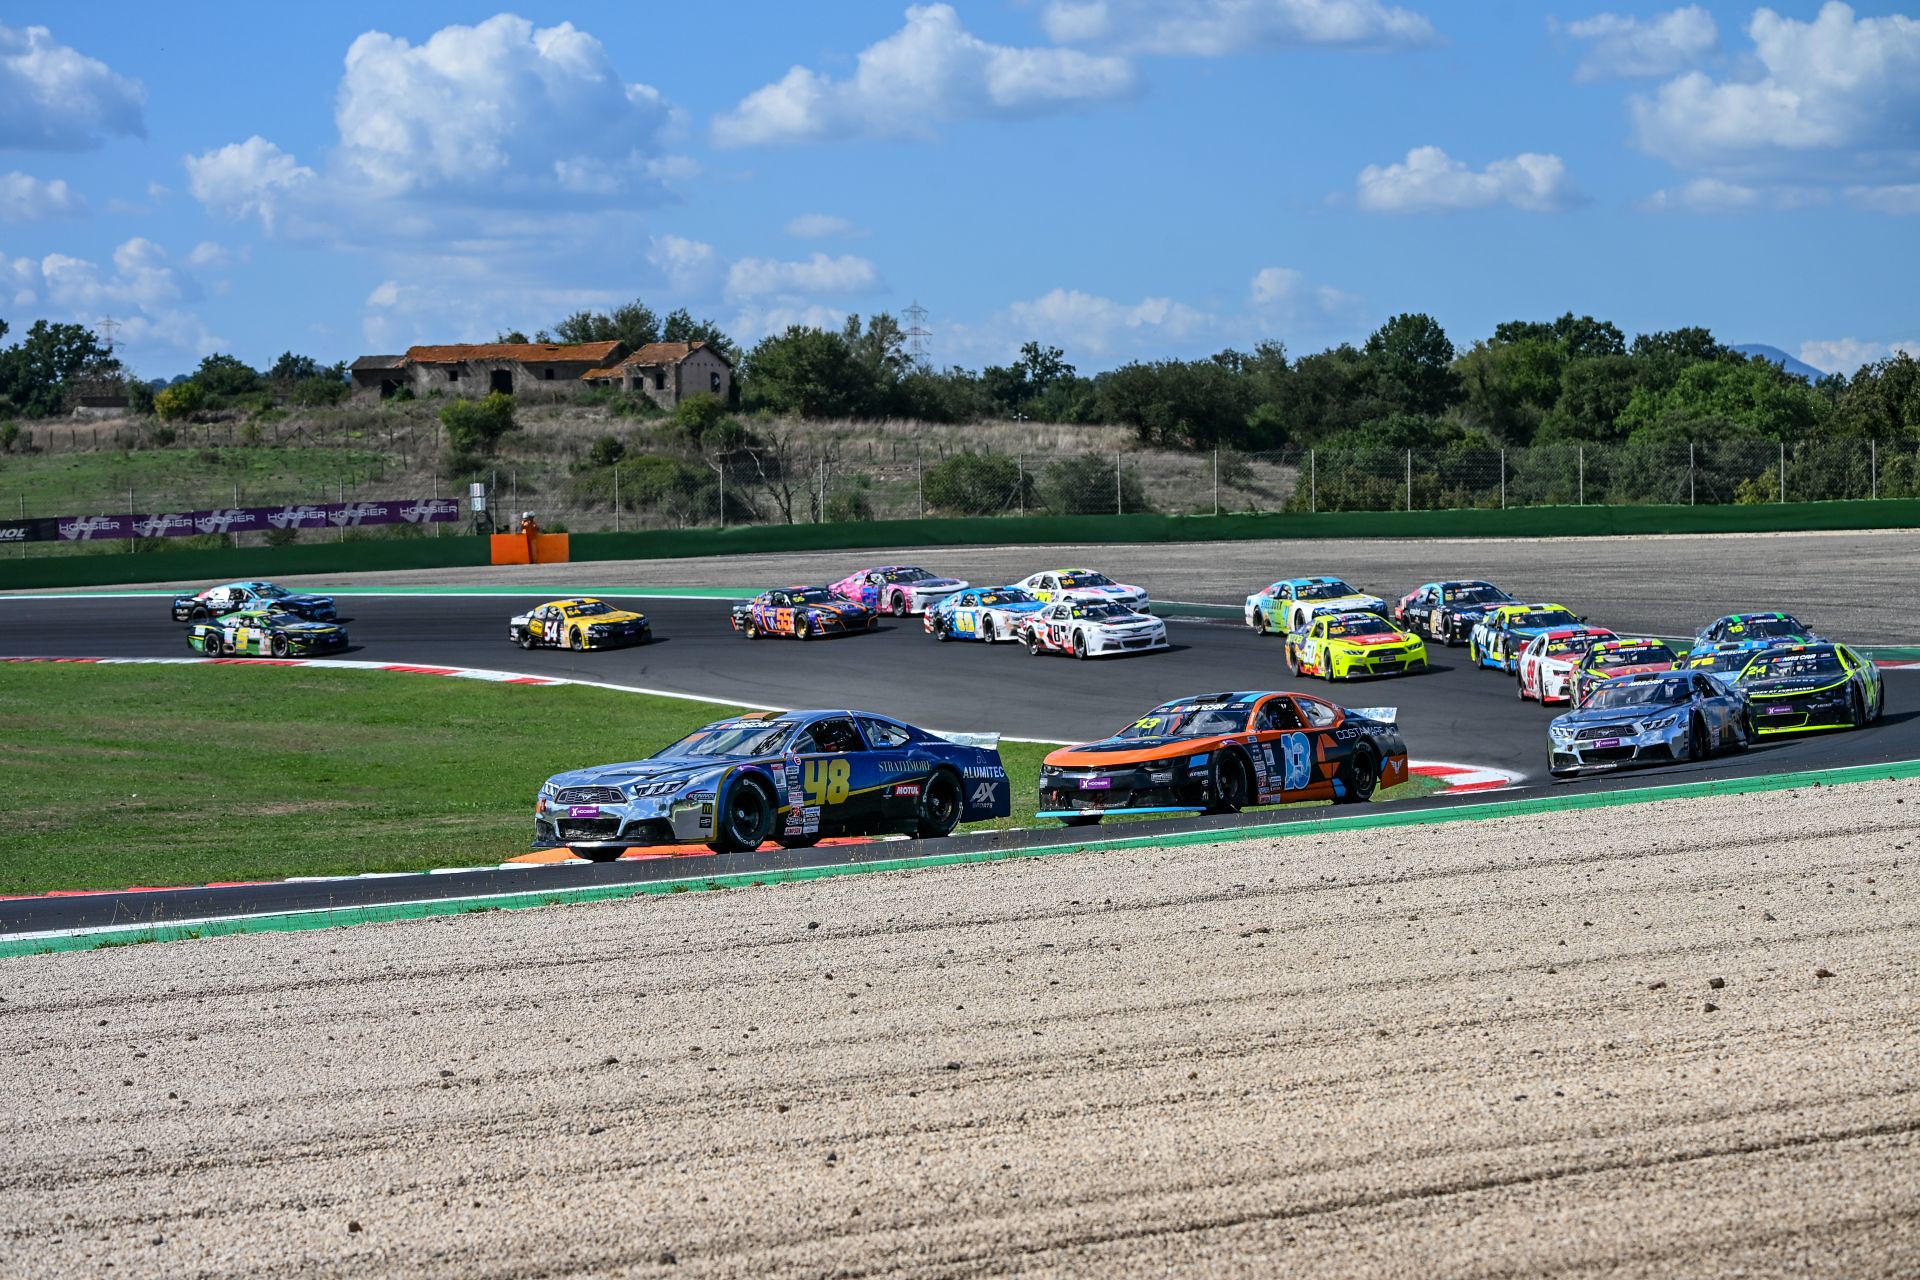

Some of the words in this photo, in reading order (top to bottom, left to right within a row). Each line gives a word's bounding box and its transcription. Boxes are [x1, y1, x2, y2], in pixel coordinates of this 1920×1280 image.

[267, 509, 326, 521] HOOSIER
[328, 507, 388, 520] HOOSIER
[399, 504, 458, 518] HOOSIER
[59, 520, 120, 532] HOOSIER
[132, 518, 193, 531] HOOSIER
[194, 513, 256, 527] HOOSIER
[775, 607, 792, 631] 55
[544, 620, 560, 642] 54
[1053, 623, 1061, 643] 8
[1780, 653, 1818, 663] NASCAR
[1747, 665, 1767, 676] 24
[1627, 679, 1665, 687] NASCAR
[1183, 703, 1228, 713] NASCAR
[1134, 717, 1161, 729] 13
[878, 759, 932, 773] STRATHMORE
[1281, 731, 1312, 791] 13
[963, 766, 1005, 779] ALUMITEC
[804, 758, 851, 805] 48
[896, 785, 920, 795] MOTUL
[969, 782, 999, 803] AX
